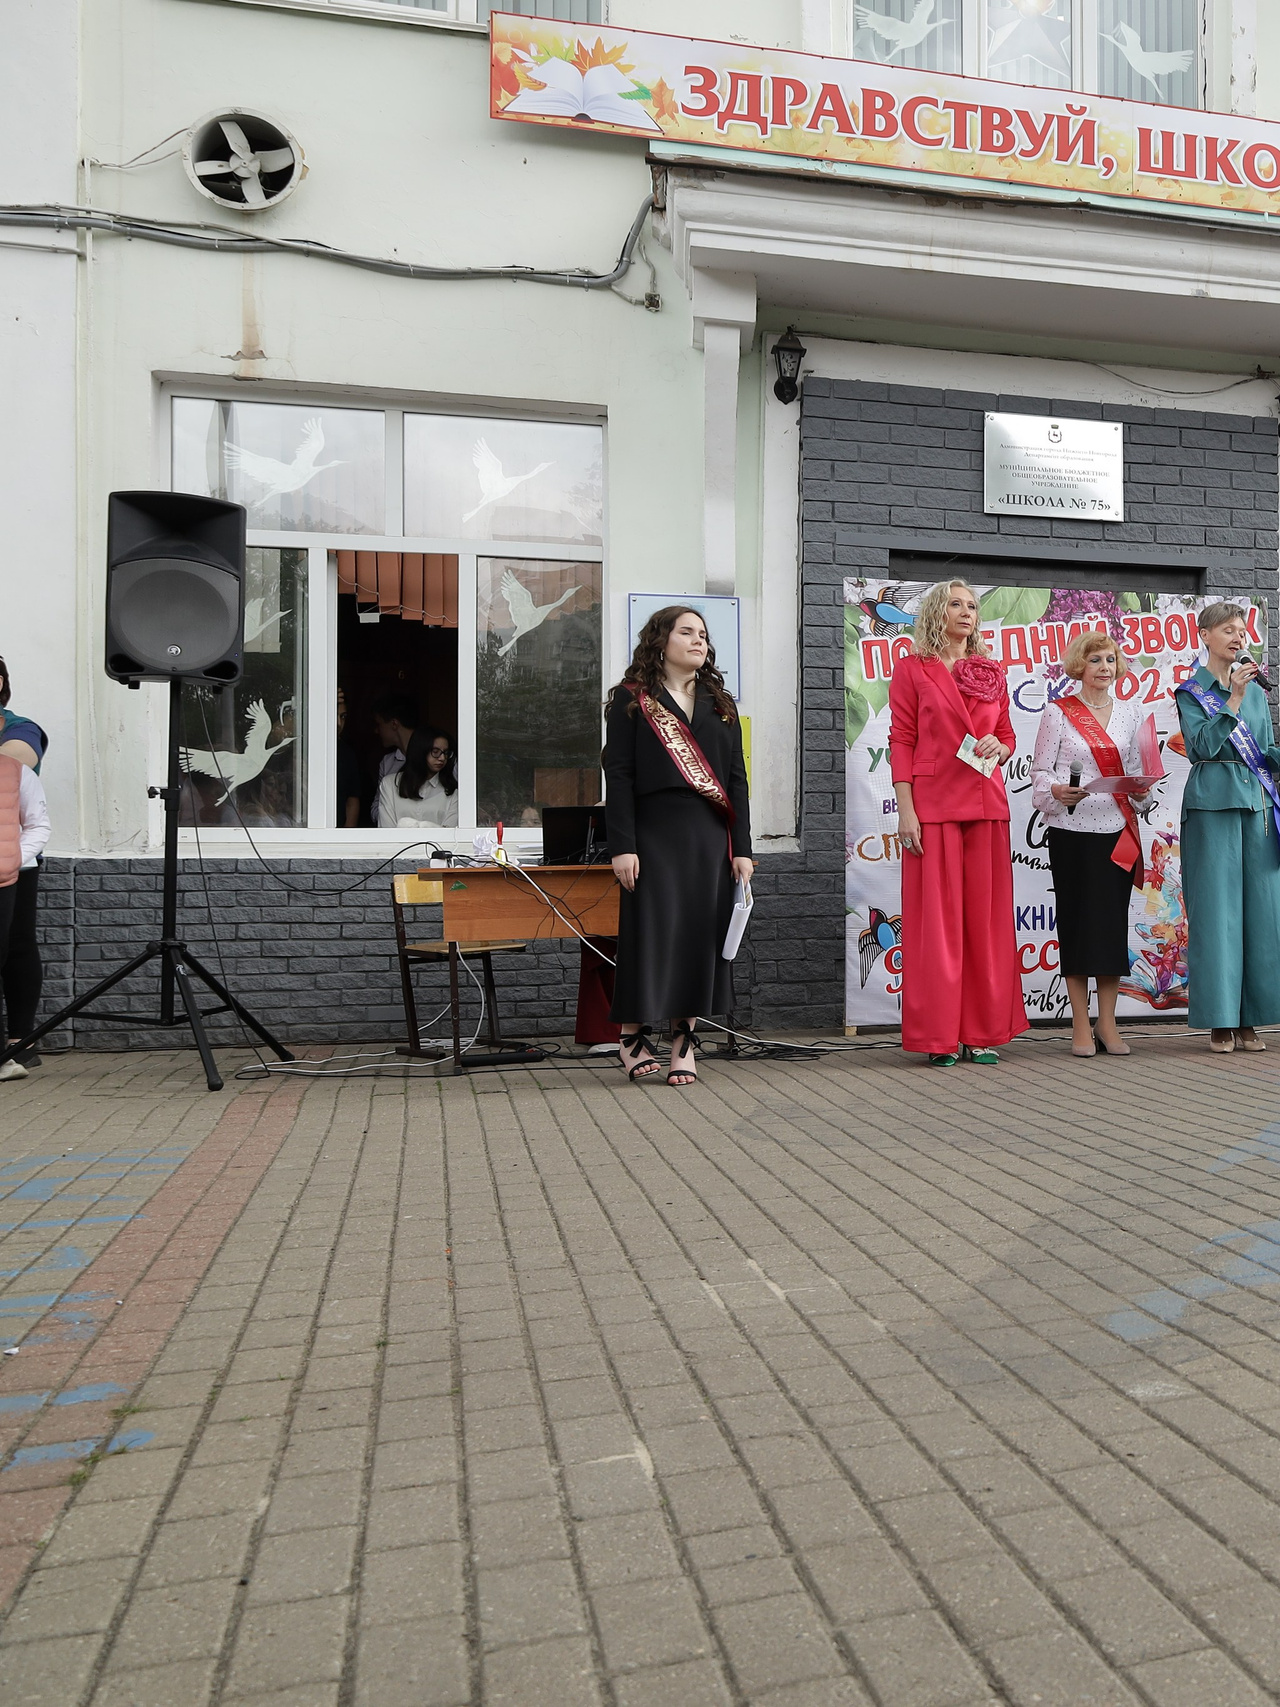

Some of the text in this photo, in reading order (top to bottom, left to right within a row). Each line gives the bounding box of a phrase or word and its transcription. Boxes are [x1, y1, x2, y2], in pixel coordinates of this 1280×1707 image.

[680, 65, 1116, 178] ЗДРАВСТВУЙ,
[1012, 473, 1098, 484] ОБЩЕОБРАЗОВАТЕЛЬНОЕ
[1031, 480, 1079, 490] УЧРЕЖДЕНИЕ
[998, 493, 1111, 511] «ШКОЛА № 75»
